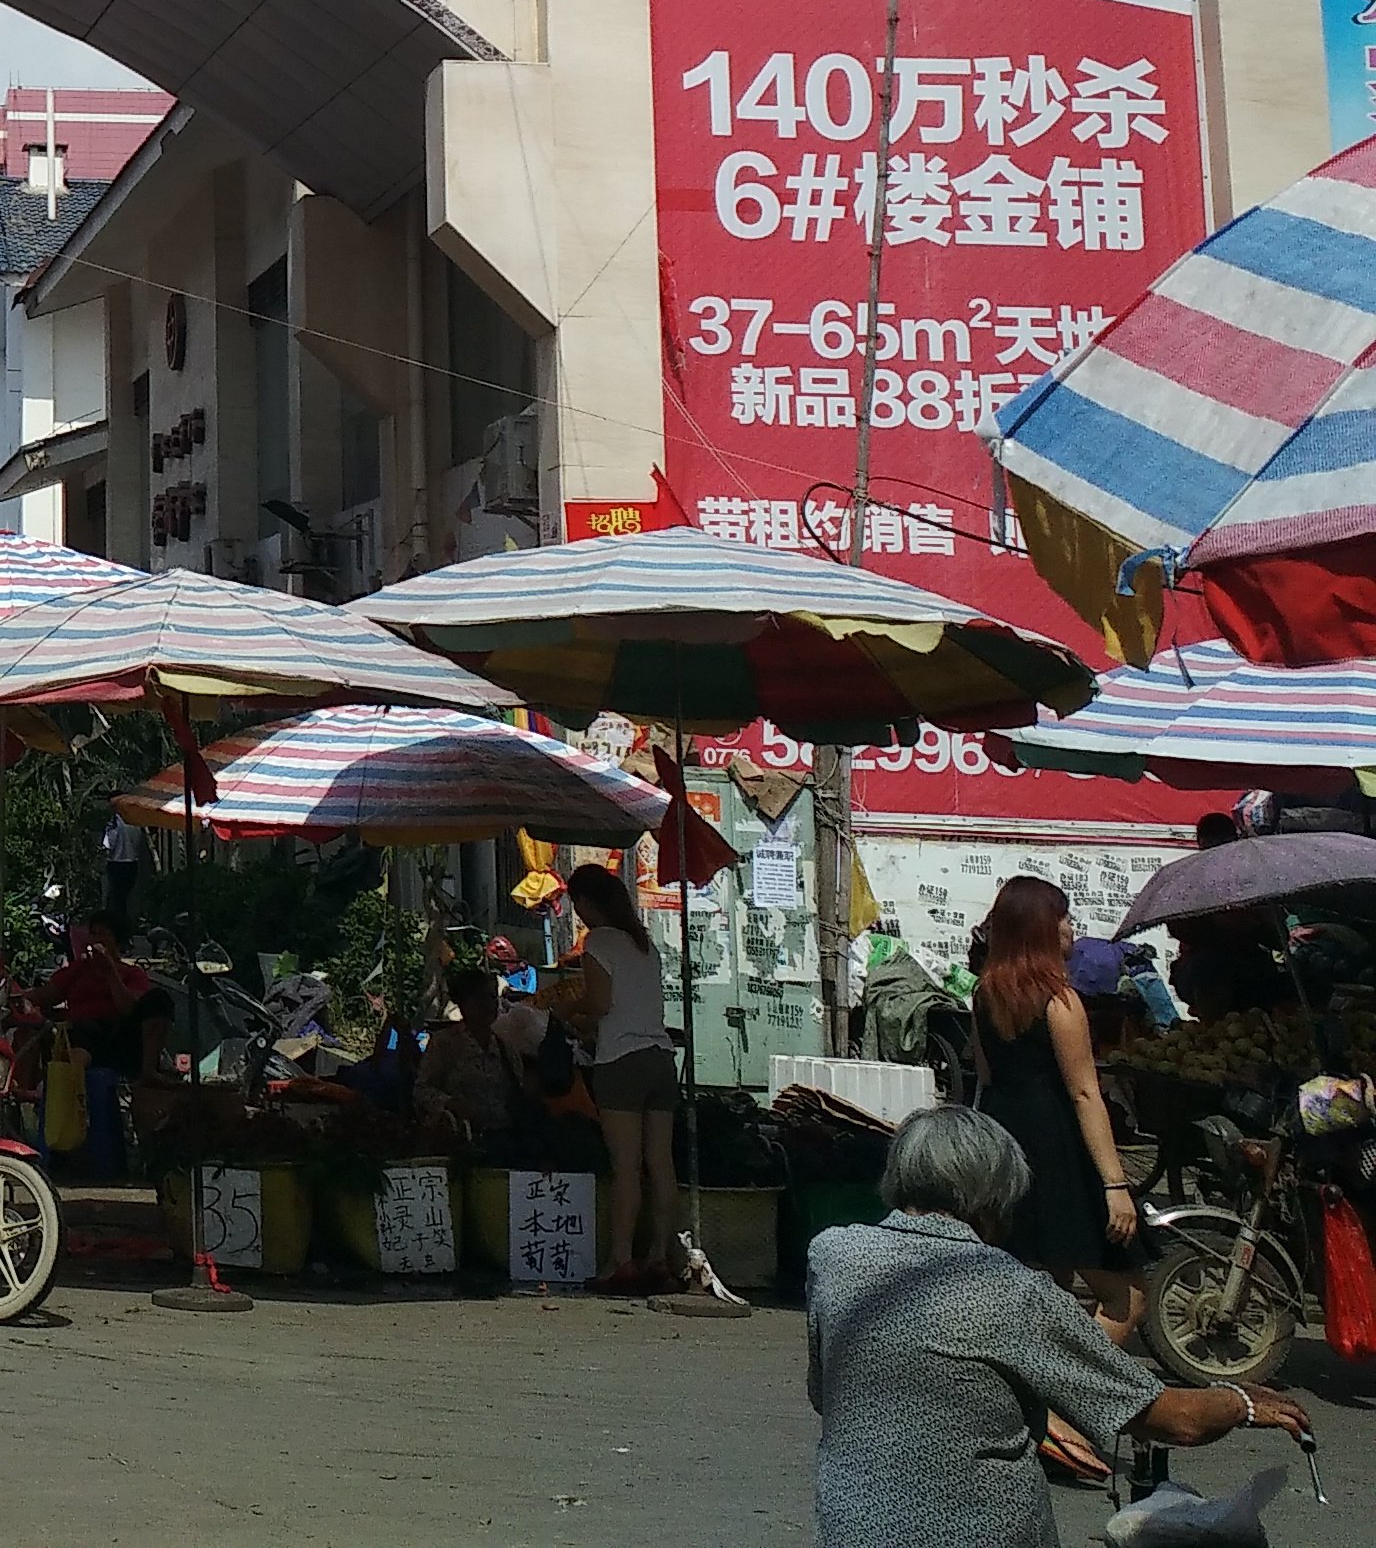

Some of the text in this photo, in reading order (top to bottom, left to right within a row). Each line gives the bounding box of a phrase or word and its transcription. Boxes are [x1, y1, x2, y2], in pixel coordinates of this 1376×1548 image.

[682, 50, 1170, 151] 140万秒杀
[715, 149, 1145, 252] 6#楼金铺
[586, 507, 642, 536] 招聘
[391, 1171, 445, 1202] 正宗
[525, 1180, 572, 1206] 正宗
[392, 1204, 444, 1231] 灵山
[519, 1209, 584, 1237] 本地
[381, 1227, 453, 1252] 妃子笑
